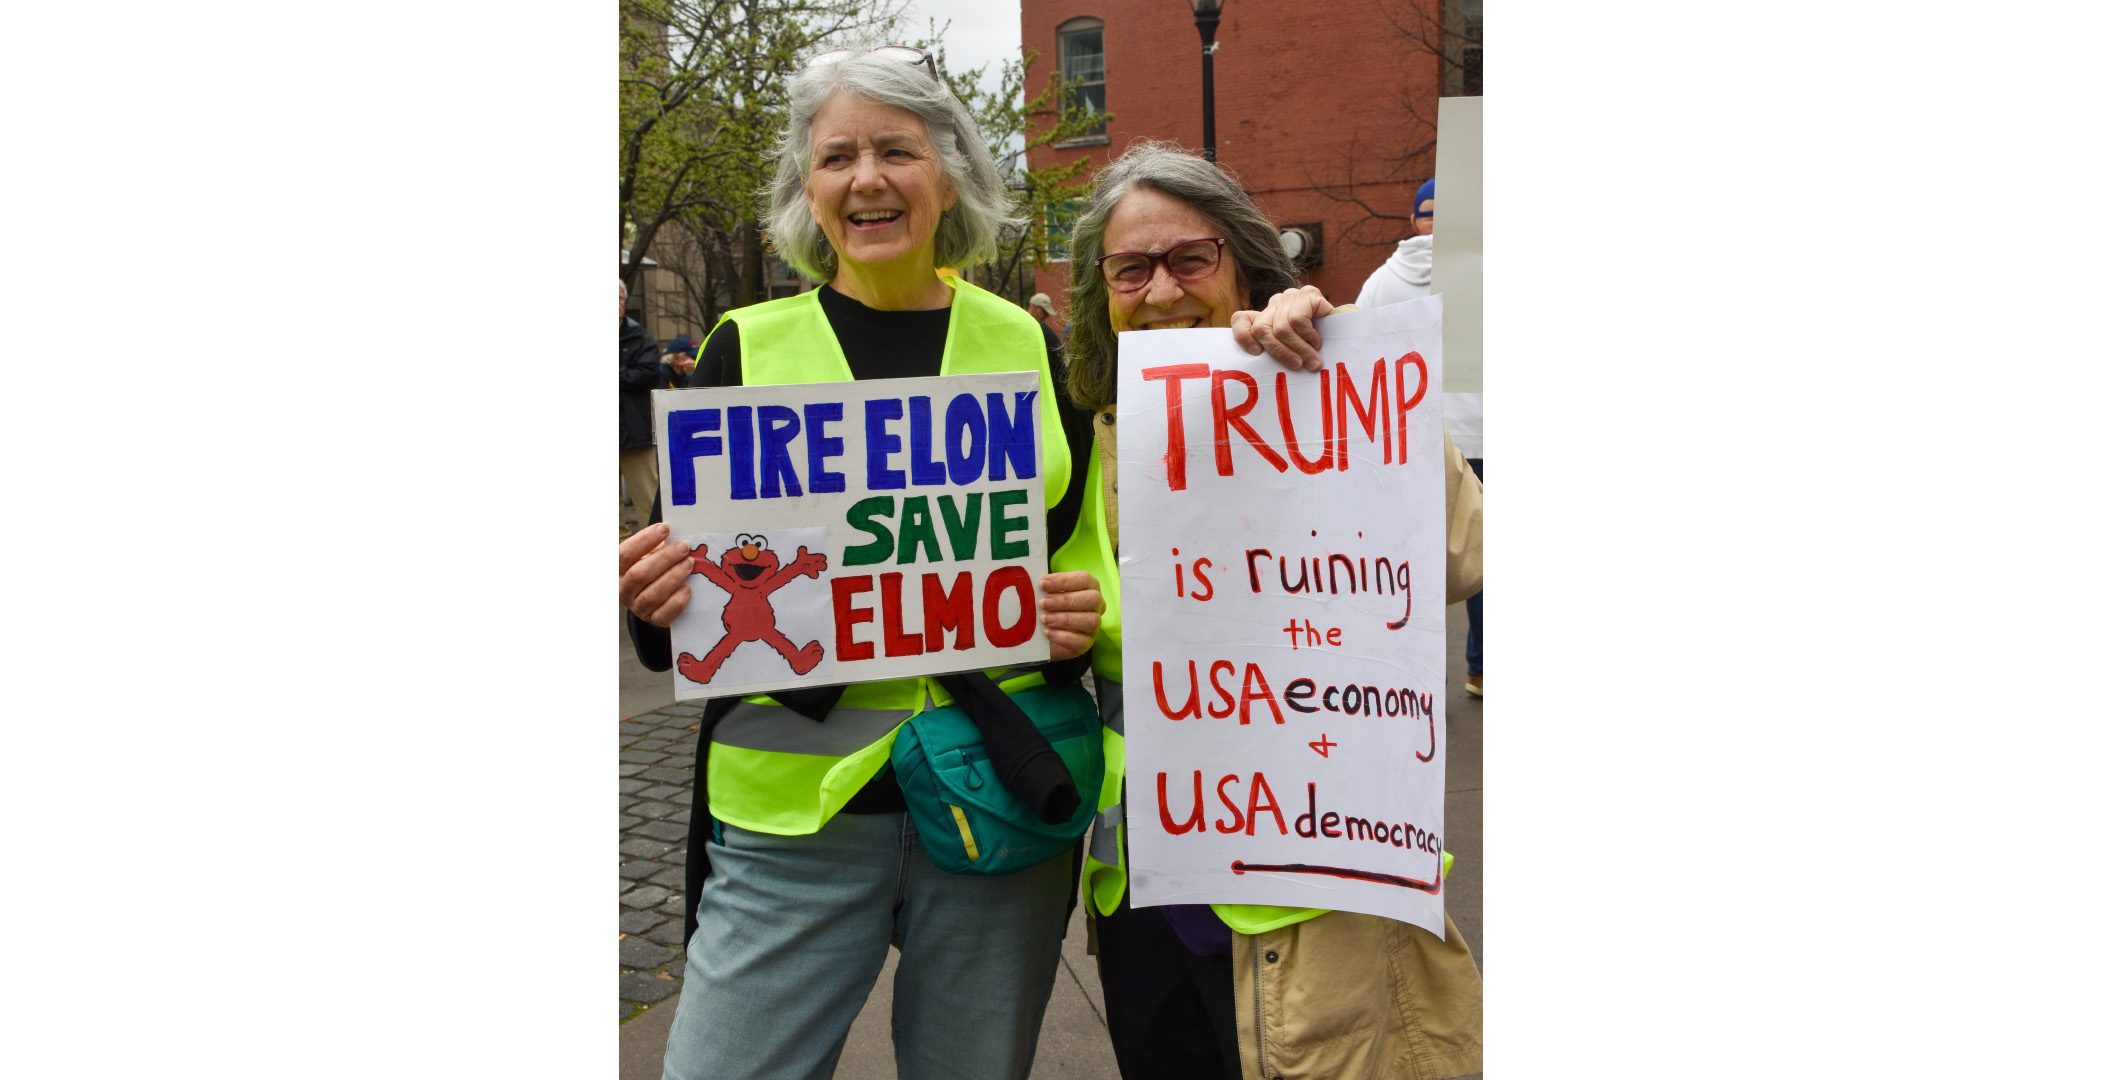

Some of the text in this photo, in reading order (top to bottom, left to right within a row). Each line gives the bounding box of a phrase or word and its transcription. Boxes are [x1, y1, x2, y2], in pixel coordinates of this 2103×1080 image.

[668, 390, 1039, 506] FIRE ELON
[1141, 350, 1428, 491] TRUMP
[842, 489, 1030, 566] SAVE
[831, 566, 1037, 662] ELMO
[1171, 529, 1412, 630] is ruining
[1283, 618, 1342, 650] the
[1152, 659, 1435, 763] USA economy
[1157, 769, 1442, 894] USA democracy
